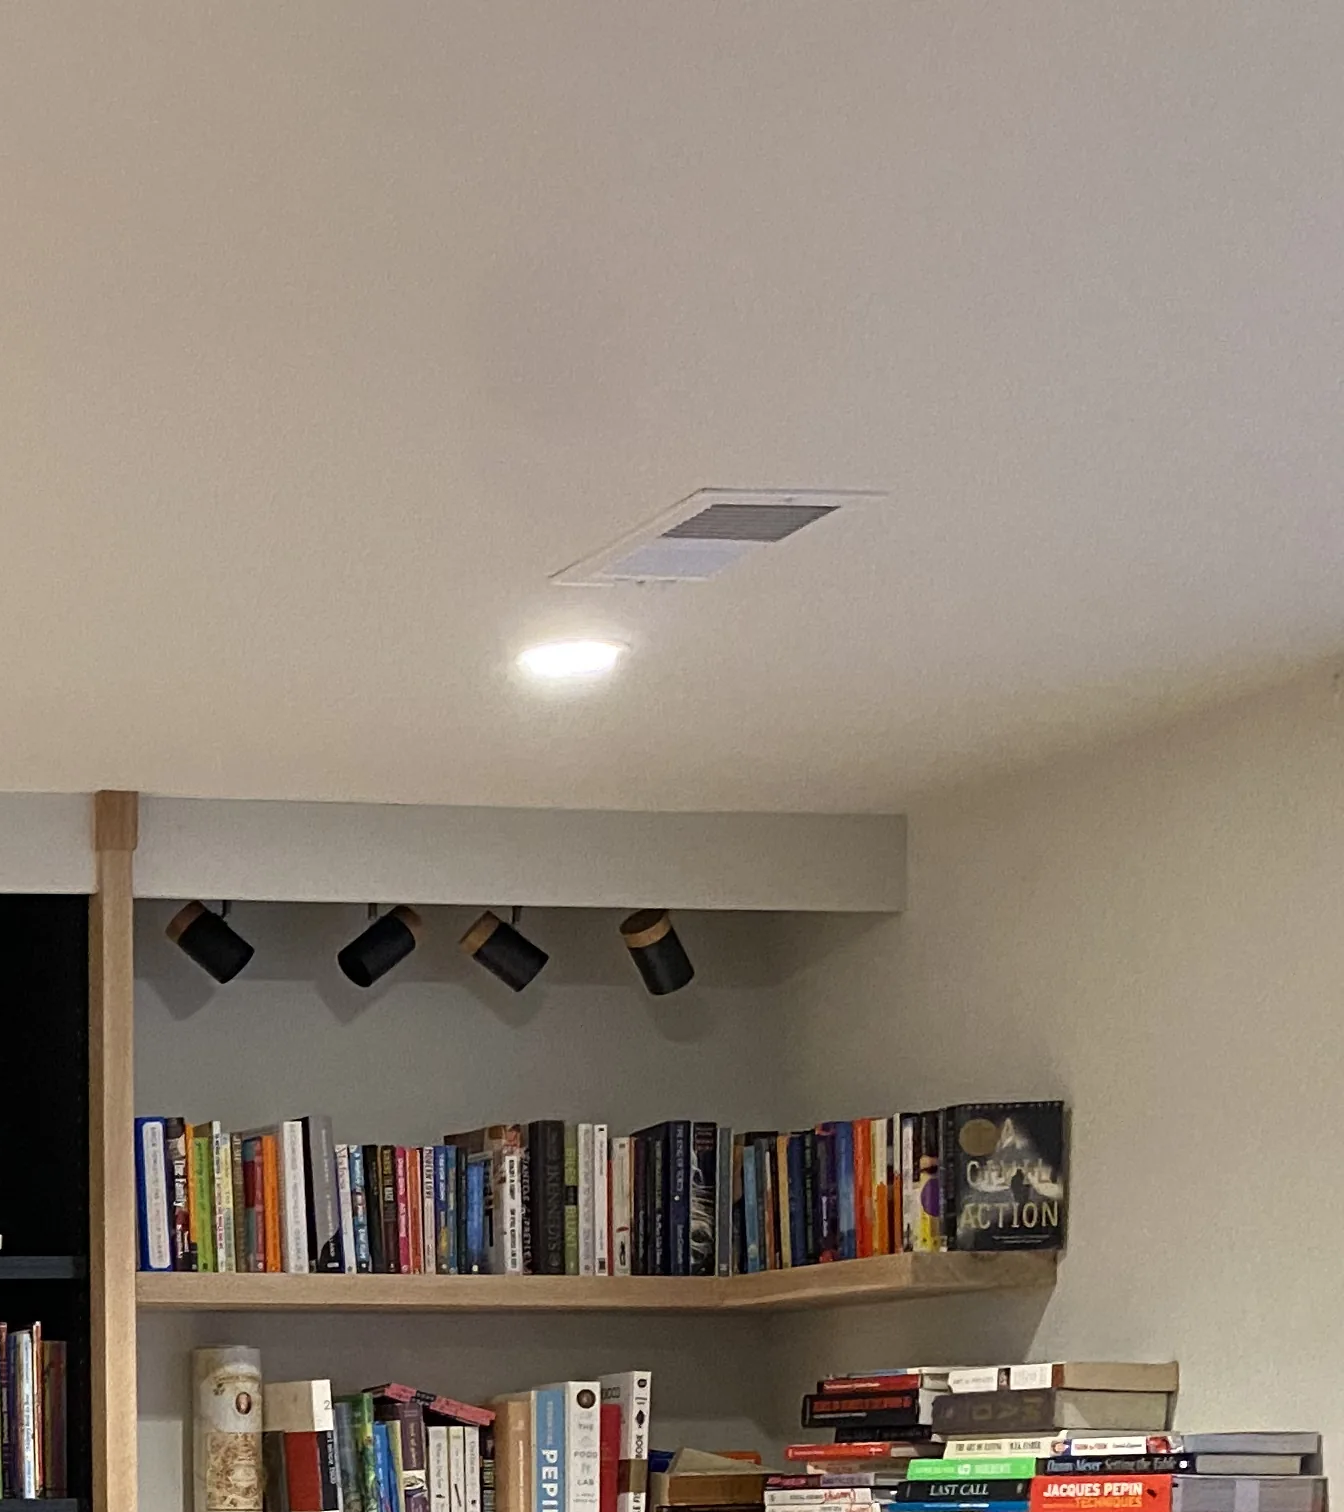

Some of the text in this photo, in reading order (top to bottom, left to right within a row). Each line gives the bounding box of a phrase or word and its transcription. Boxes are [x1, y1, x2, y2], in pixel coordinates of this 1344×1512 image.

[565, 1147, 577, 1250] GILES BLUNT
[960, 1201, 1058, 1229] ACTION
[574, 1451, 598, 1459] FOOD
[577, 1478, 594, 1487] LAB
[1043, 1481, 1143, 1498] JACQUES PEPIN
[929, 1483, 989, 1497] LAST CALL
[1075, 1497, 1143, 1509] TECHNIQUES
